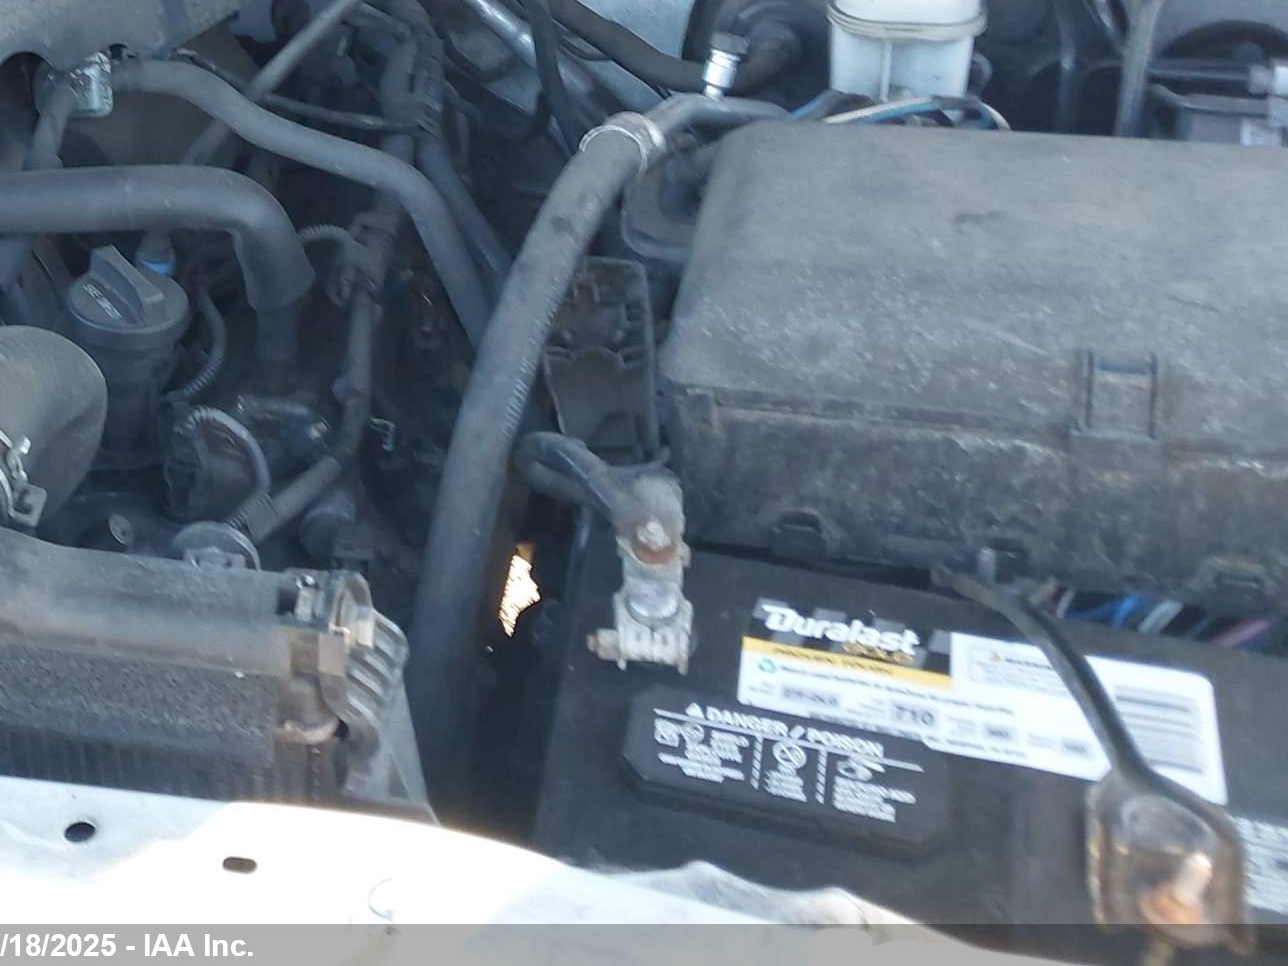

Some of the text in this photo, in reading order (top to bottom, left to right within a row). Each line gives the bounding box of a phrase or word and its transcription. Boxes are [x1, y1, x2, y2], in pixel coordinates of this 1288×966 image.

[761, 604, 921, 654] Duralast
[707, 707, 788, 737] DANGER
[807, 727, 884, 758] POISON
[895, 705, 935, 726] 710
